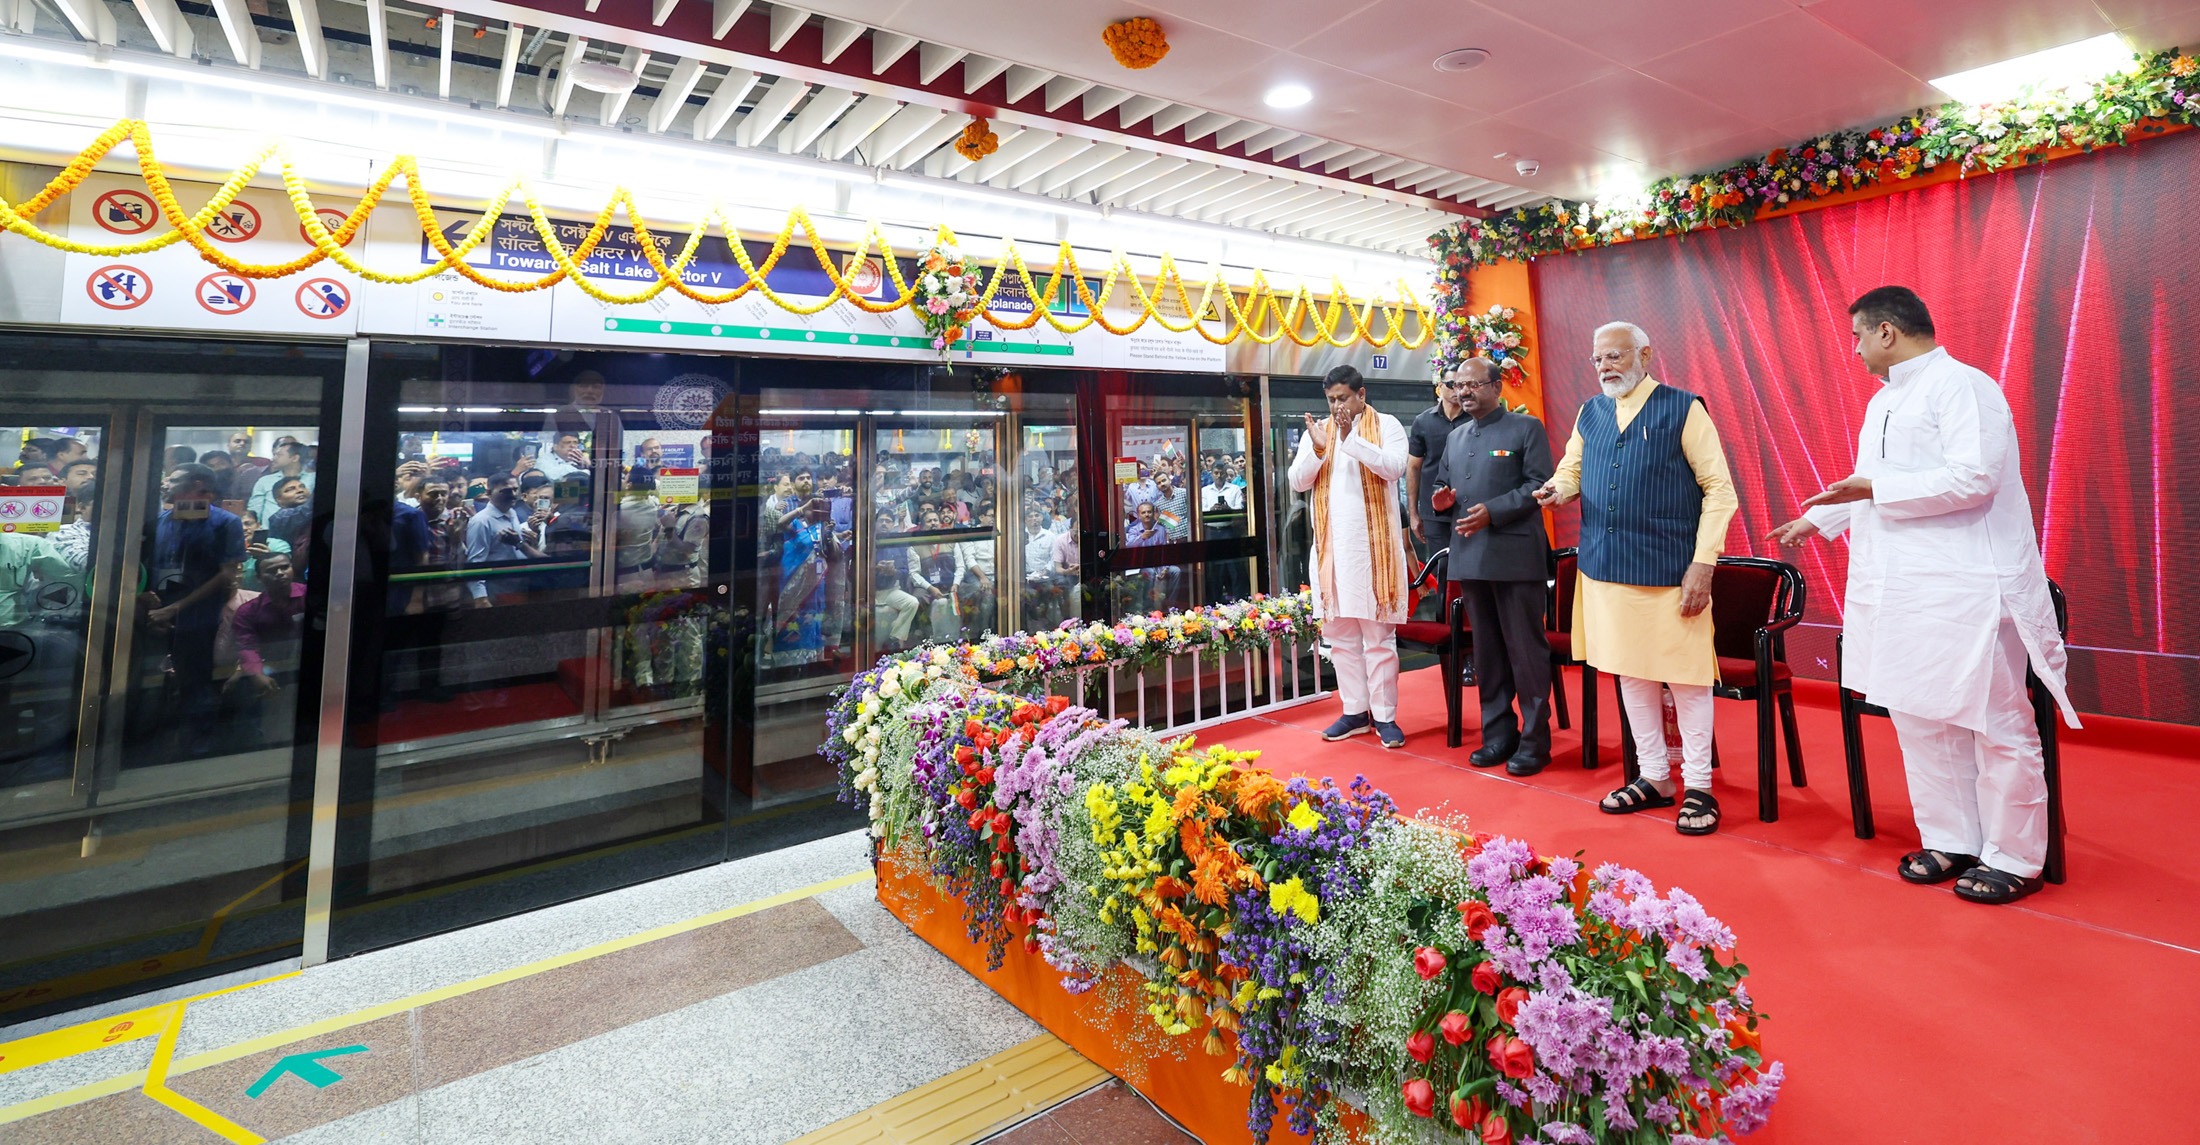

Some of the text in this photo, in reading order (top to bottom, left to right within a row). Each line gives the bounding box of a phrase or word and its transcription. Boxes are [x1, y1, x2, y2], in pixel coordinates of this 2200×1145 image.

[604, 230, 614, 242] V
[630, 250, 642, 262] V
[578, 260, 610, 275] Salt
[615, 263, 653, 278] Lake
[712, 272, 722, 284] V
[987, 298, 1034, 311] splanade
[1376, 357, 1385, 368] 17
